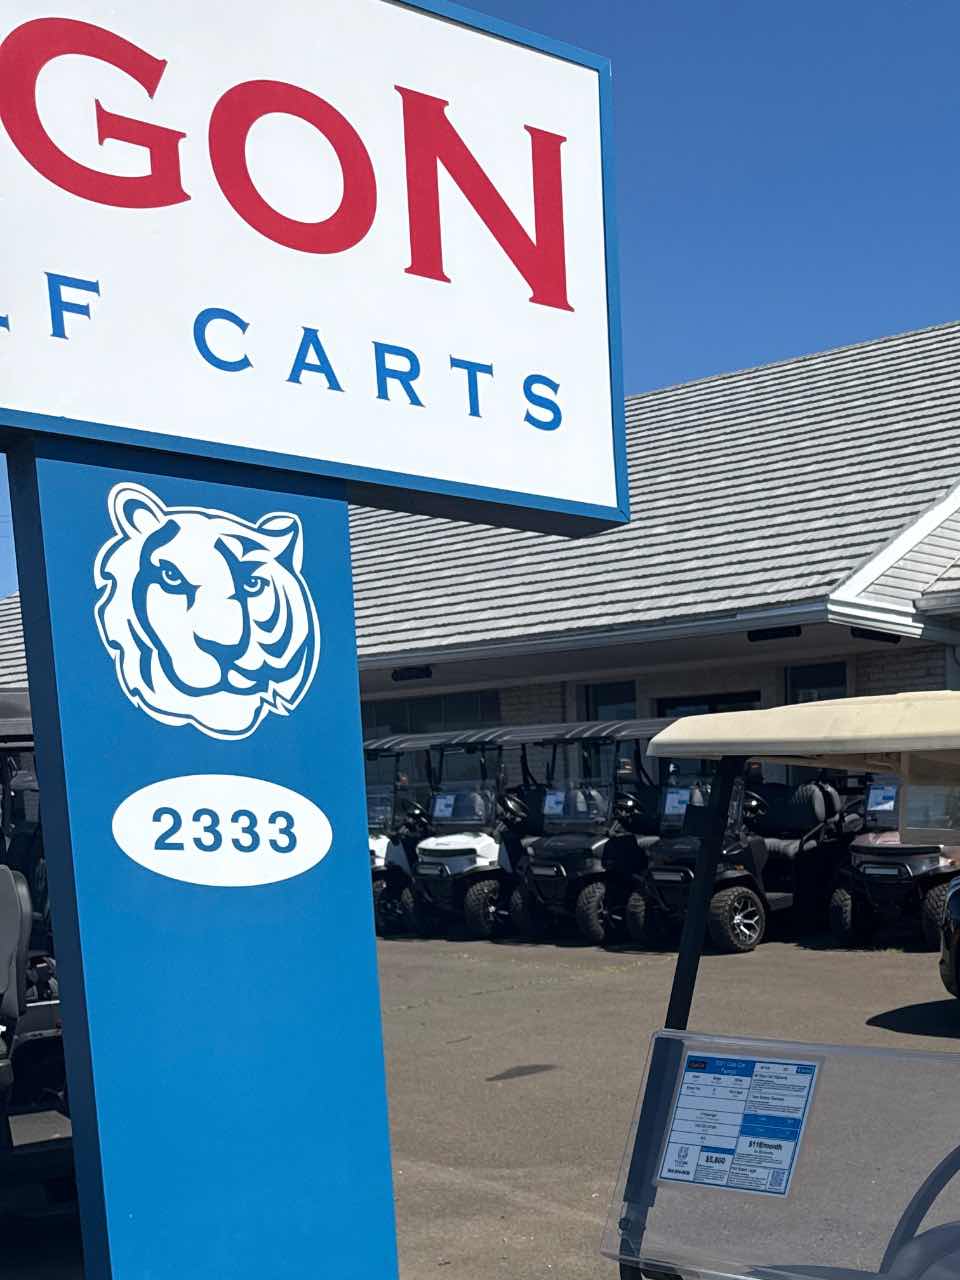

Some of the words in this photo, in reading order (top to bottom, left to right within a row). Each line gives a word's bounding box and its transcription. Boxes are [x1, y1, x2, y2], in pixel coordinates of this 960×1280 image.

[0, 272, 100, 340] F
[193, 308, 563, 431] CARTS
[152, 807, 297, 853] 2333
